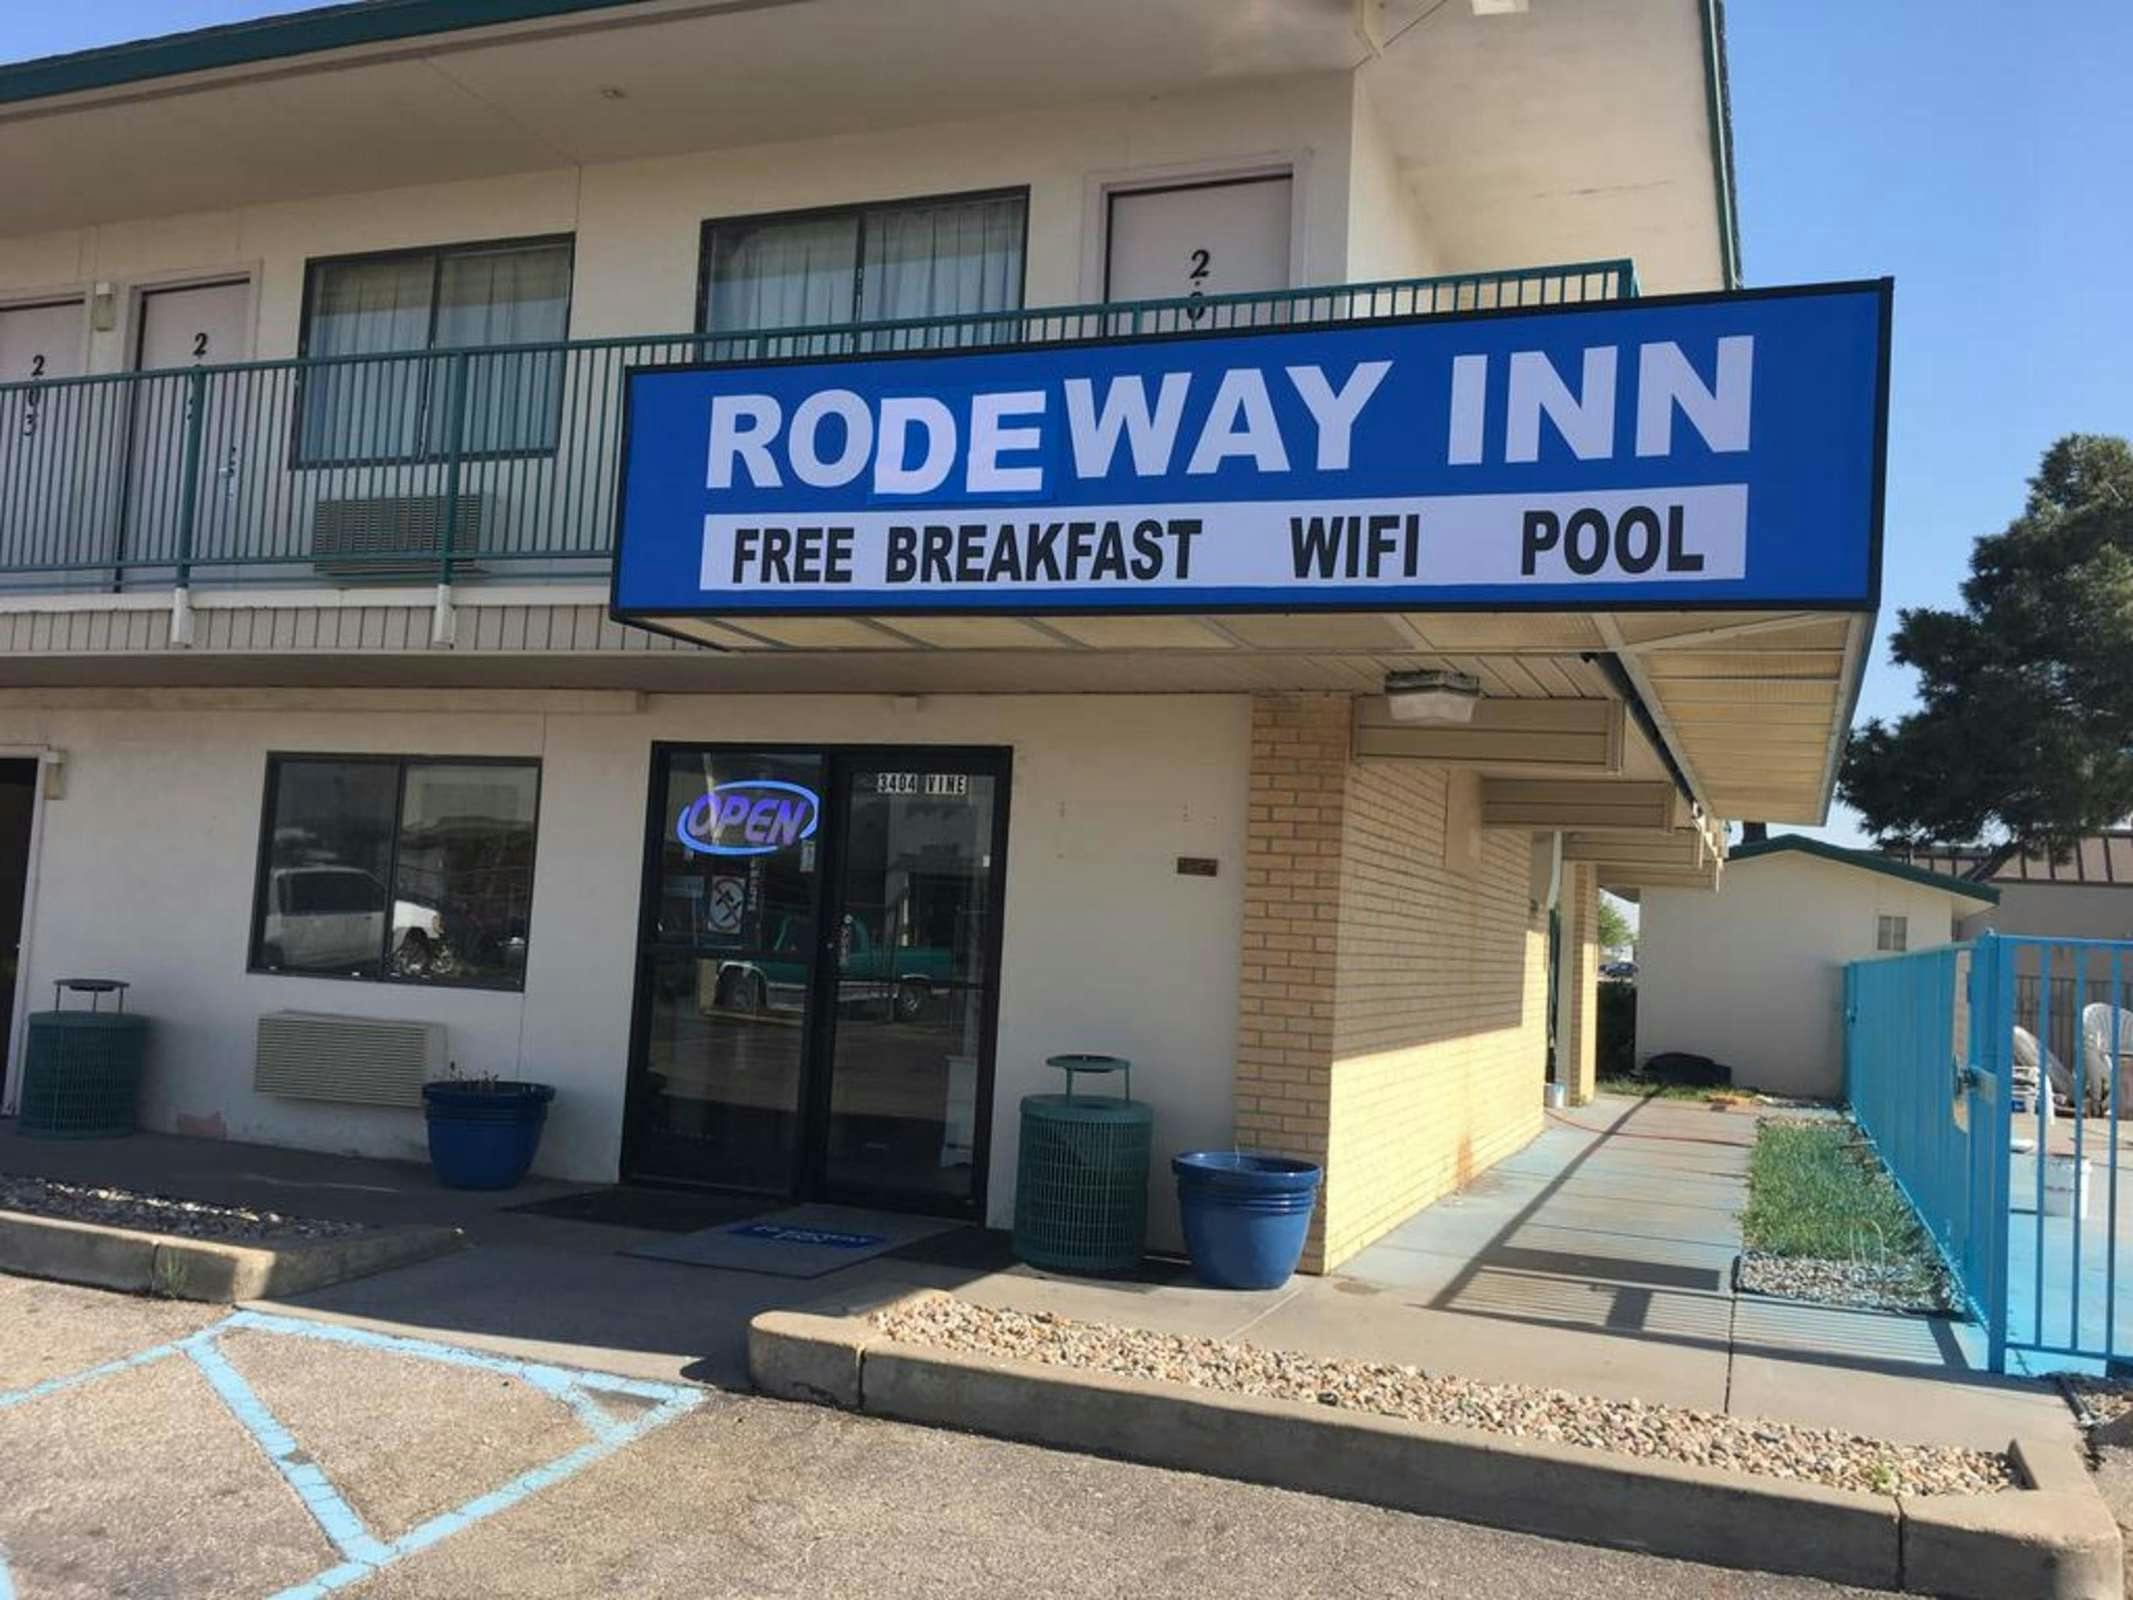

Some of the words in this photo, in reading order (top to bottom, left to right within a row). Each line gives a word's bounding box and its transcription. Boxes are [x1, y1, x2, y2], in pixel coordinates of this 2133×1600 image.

[704, 360, 1394, 495] RODEWAY
[1447, 335, 1755, 466] INN
[732, 526, 855, 584] FREE
[884, 518, 1203, 584] BREAKFAST
[1289, 513, 1421, 579] WIFI
[1520, 505, 1705, 577] POOL
[686, 793, 806, 846] OPEN
